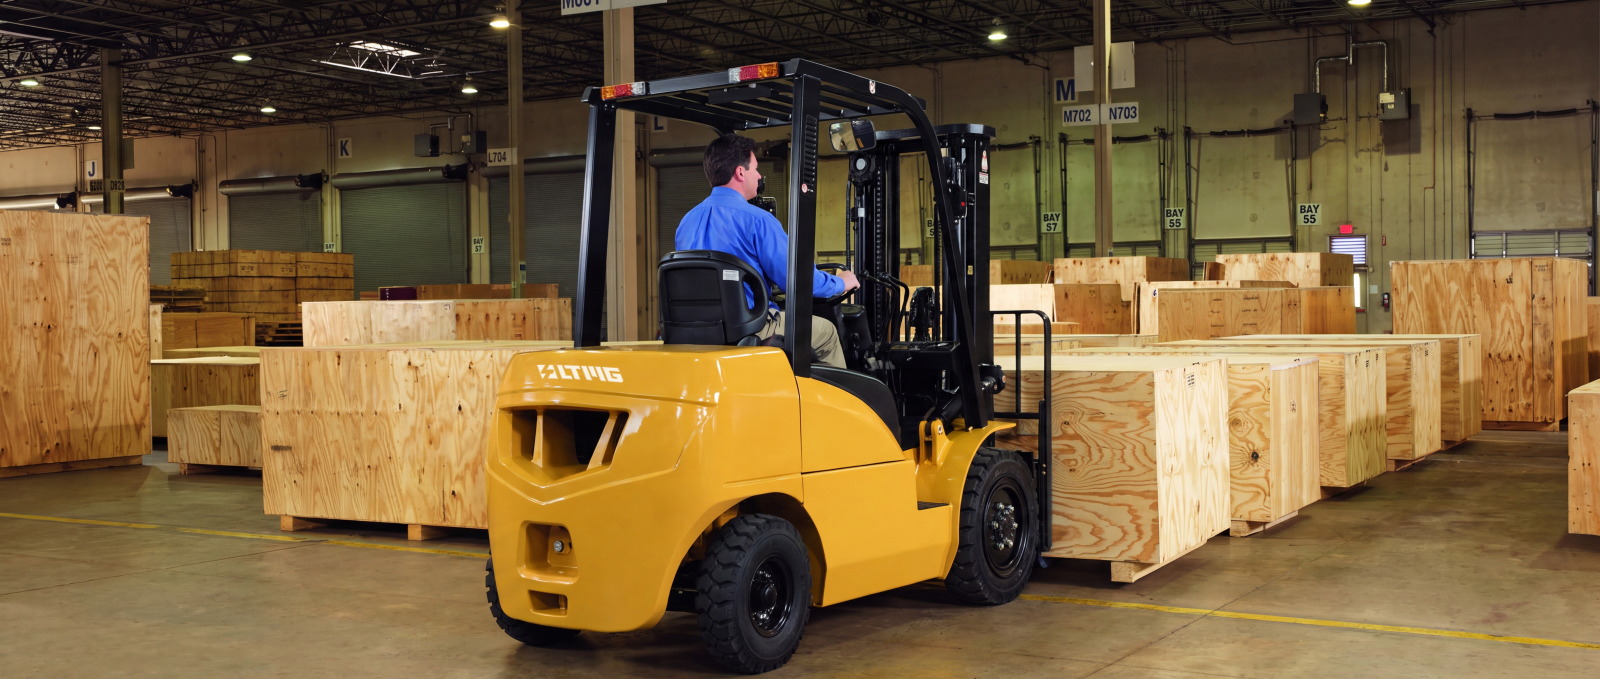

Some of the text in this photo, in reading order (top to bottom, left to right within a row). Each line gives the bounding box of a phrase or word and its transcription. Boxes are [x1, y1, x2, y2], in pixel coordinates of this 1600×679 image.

[1056, 79, 1075, 101] M
[1063, 109, 1091, 122] M702
[1109, 106, 1137, 120] N703
[340, 140, 349, 156] K
[488, 151, 507, 162] L704
[88, 161, 95, 177] J
[1165, 208, 1184, 217] BAY
[1300, 204, 1320, 214] BAY
[1043, 213, 1061, 222] BAY
[1169, 218, 1181, 228] 55
[1303, 214, 1316, 224] 55
[556, 364, 624, 383] LTMG
